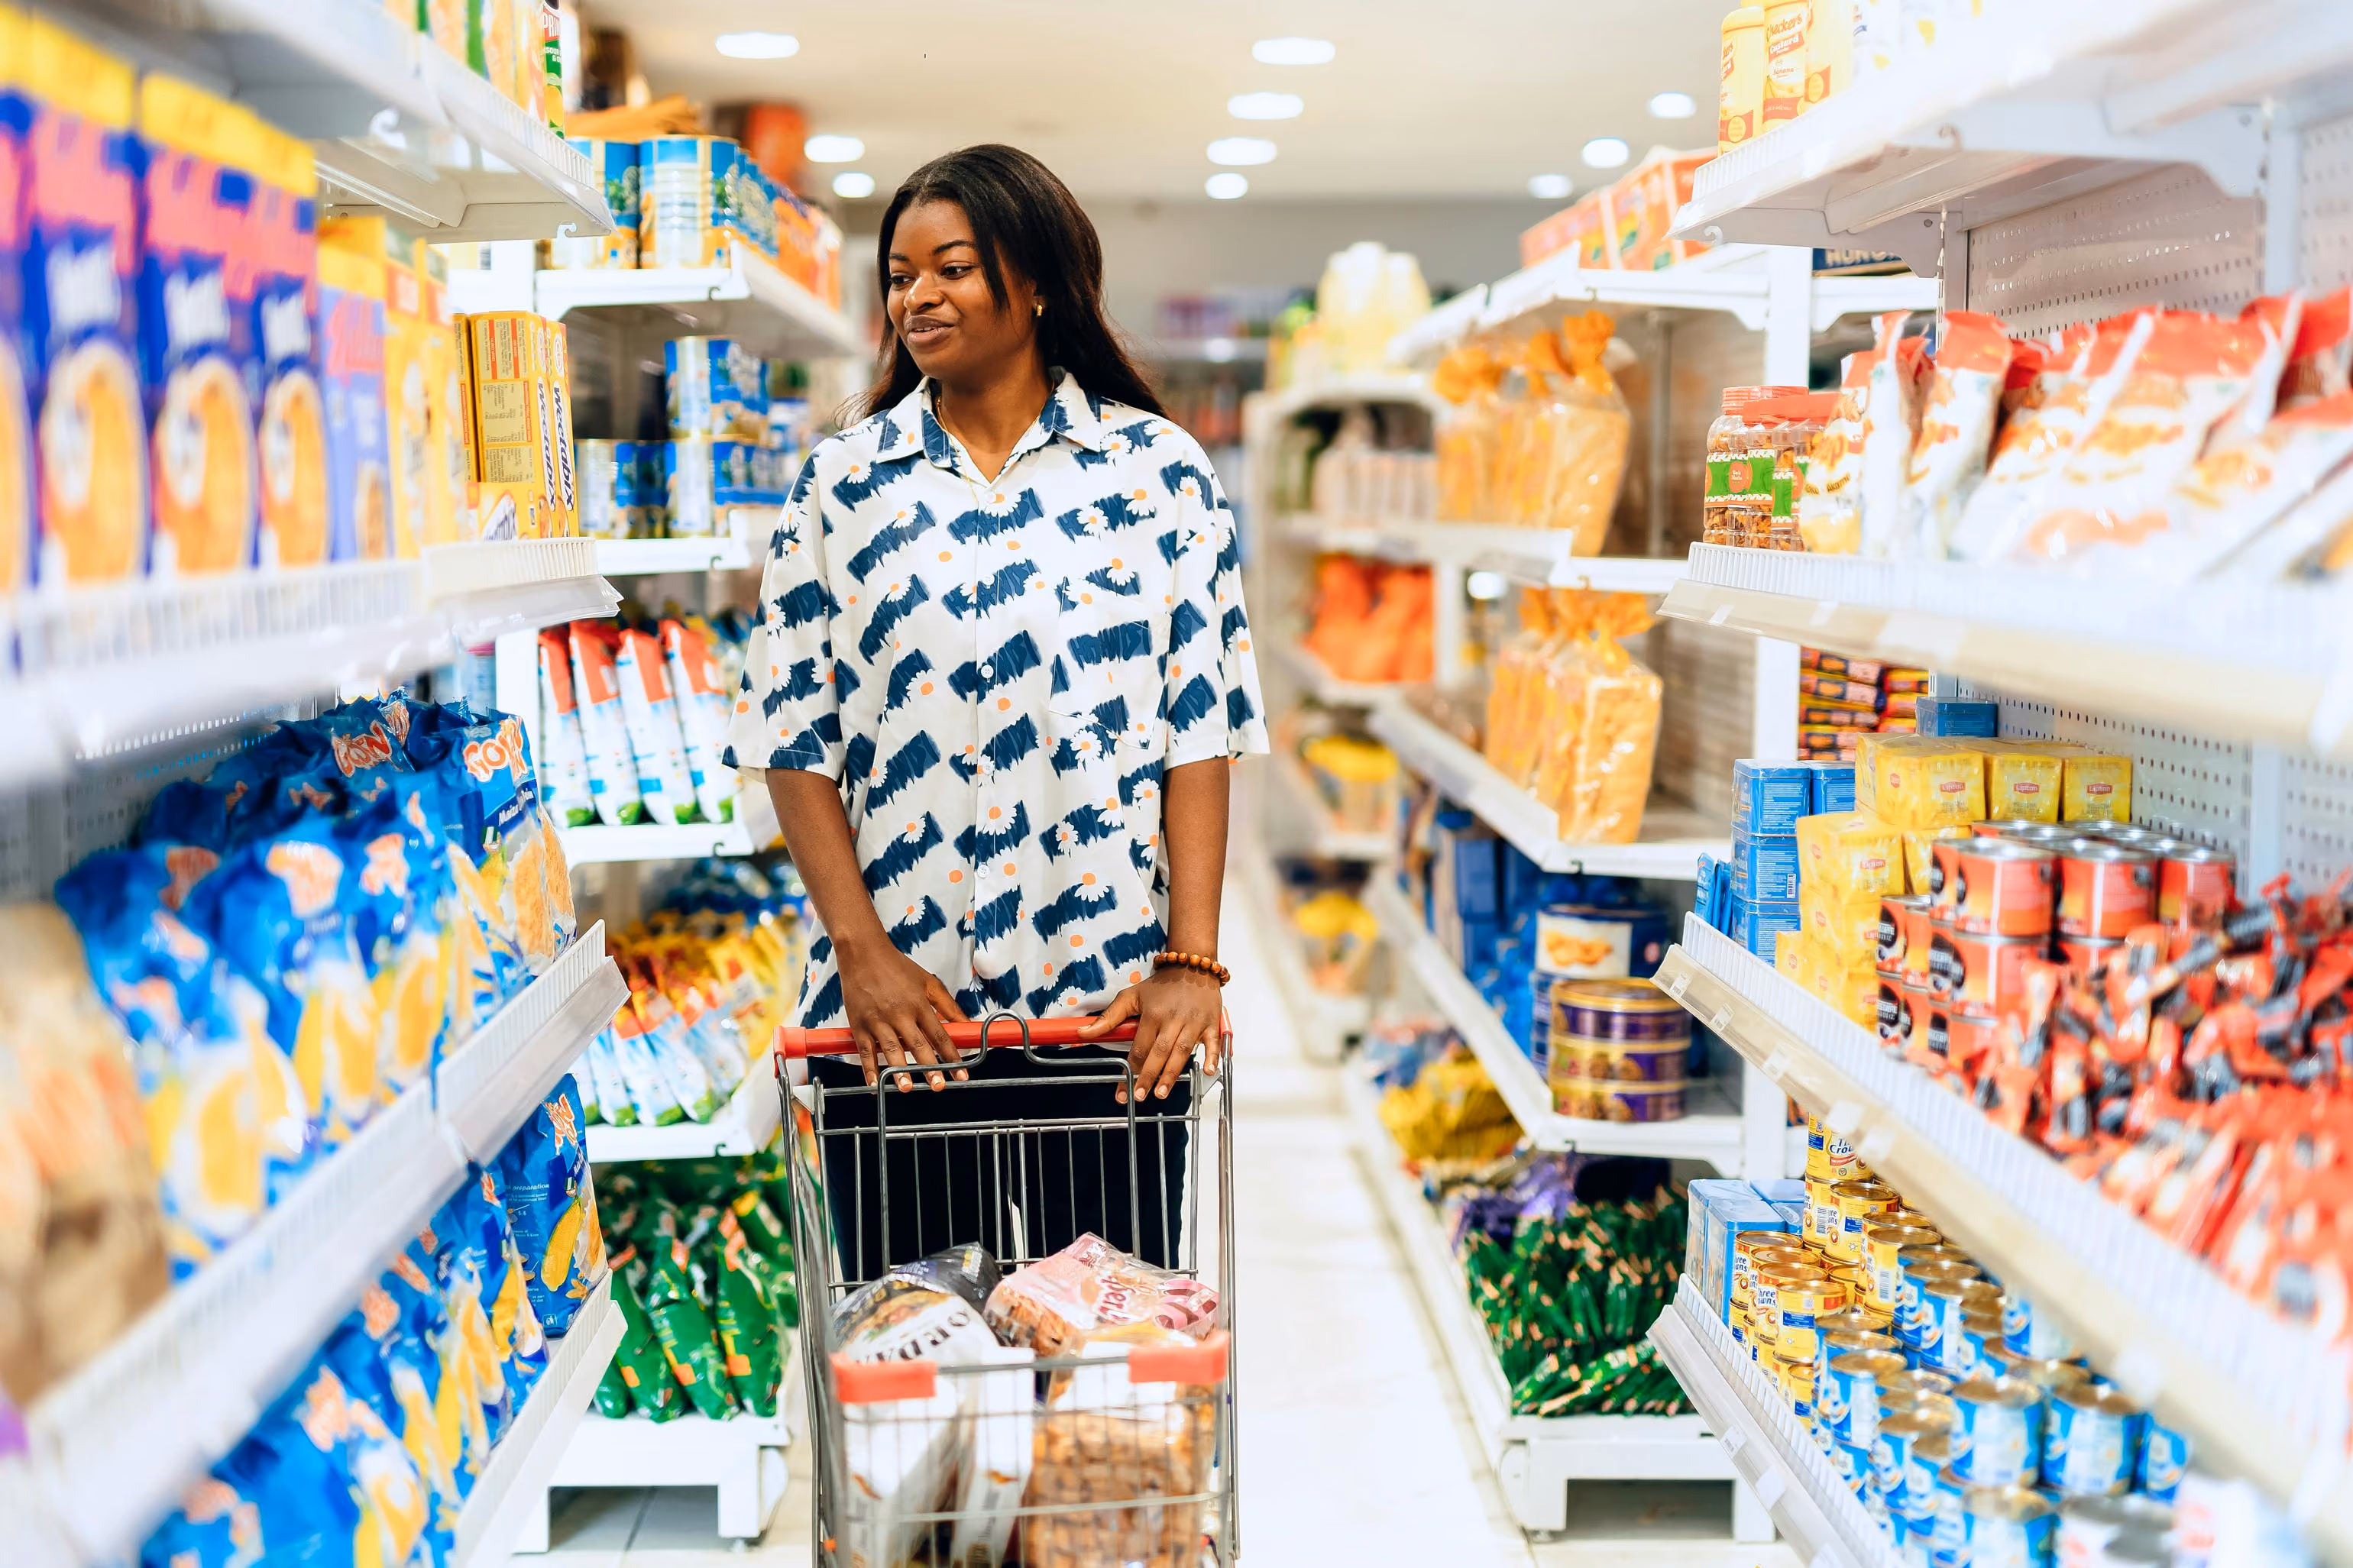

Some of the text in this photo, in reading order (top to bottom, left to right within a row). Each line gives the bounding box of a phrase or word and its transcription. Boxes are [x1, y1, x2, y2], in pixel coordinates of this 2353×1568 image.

[537, 383, 556, 506] Weetabix
[553, 387, 574, 508] Weetabix
[2088, 785, 2112, 794] Lipton
